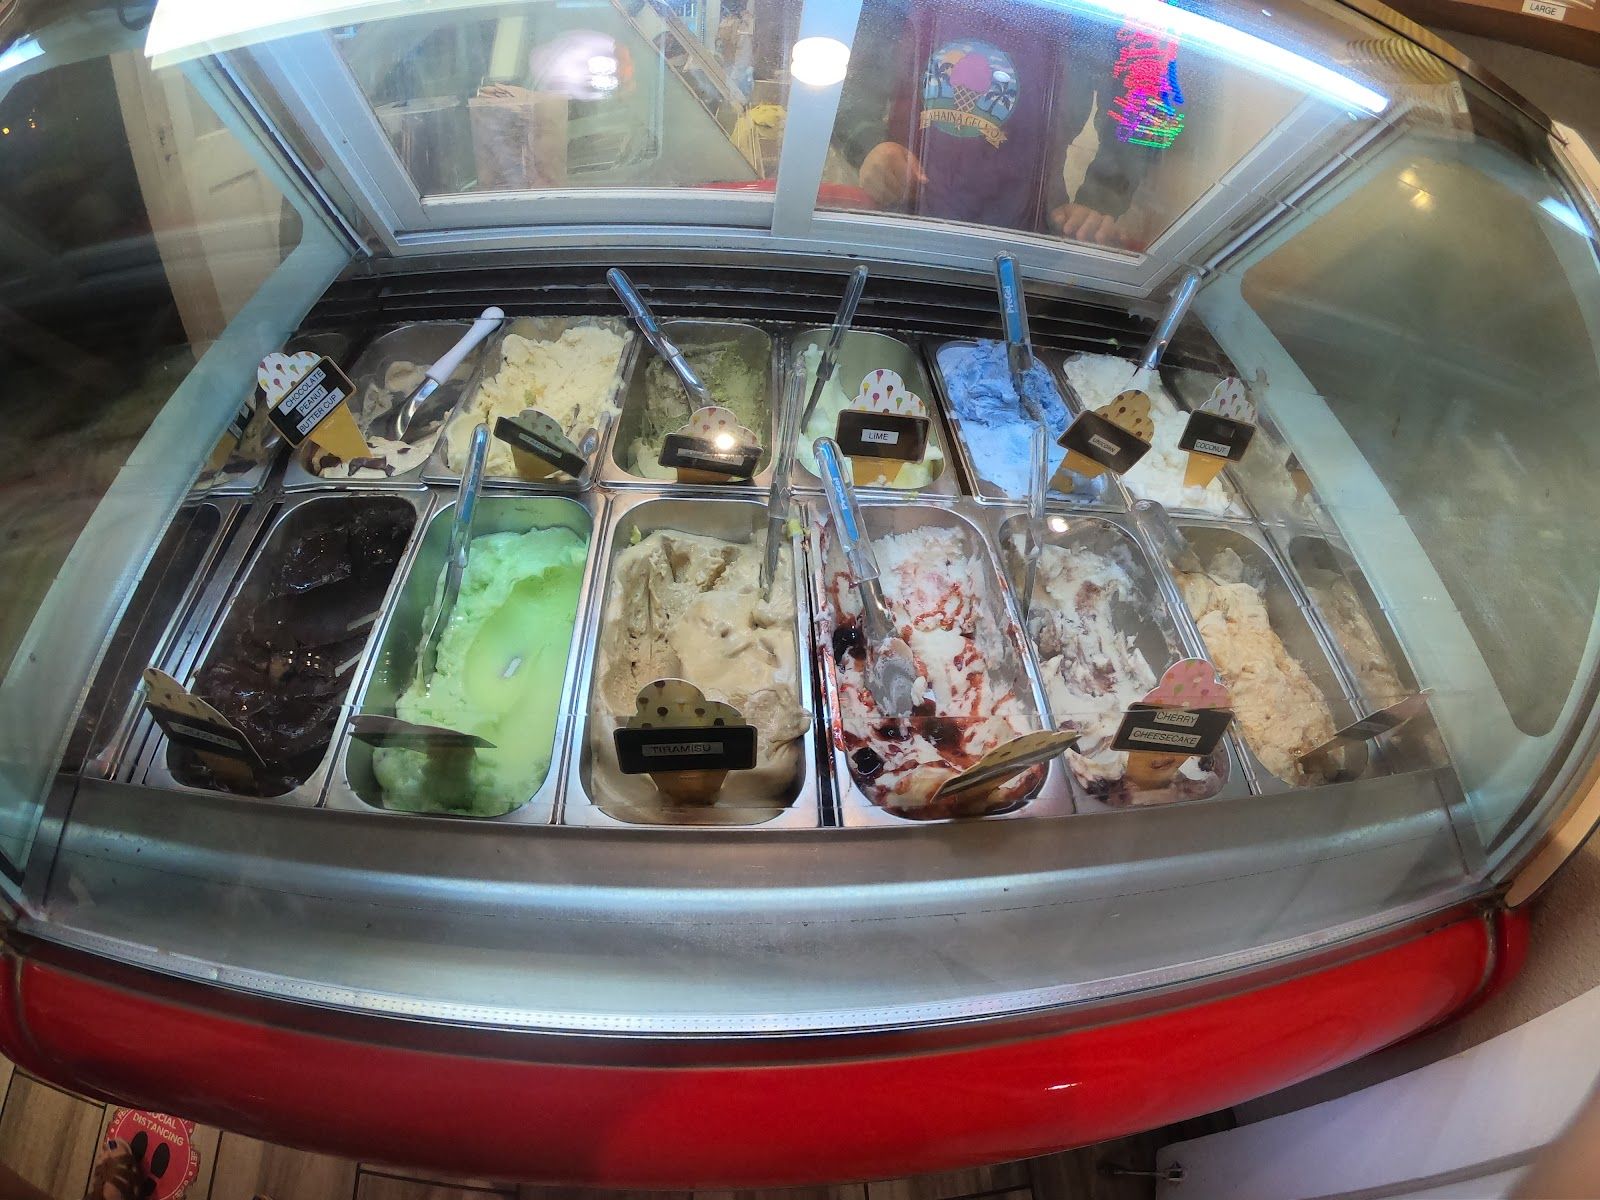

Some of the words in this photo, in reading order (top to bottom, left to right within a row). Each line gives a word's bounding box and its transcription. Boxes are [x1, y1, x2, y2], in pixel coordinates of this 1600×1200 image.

[1530, 4, 1557, 15] LARGE
[285, 369, 324, 408] CHOCOLATE
[299, 387, 325, 413] PEANUT
[299, 407, 325, 433] BUTTER
[323, 394, 337, 409] CUP
[868, 432, 889, 441] LIME
[1092, 438, 1116, 453] UNICORN
[1195, 442, 1227, 453] COCONUT
[1156, 711, 1197, 724] CHERRY
[1133, 730, 1199, 745] CHEESECAKE
[651, 743, 713, 753] TIRAMISU
[132, 1112, 184, 1146] DISTANCING
